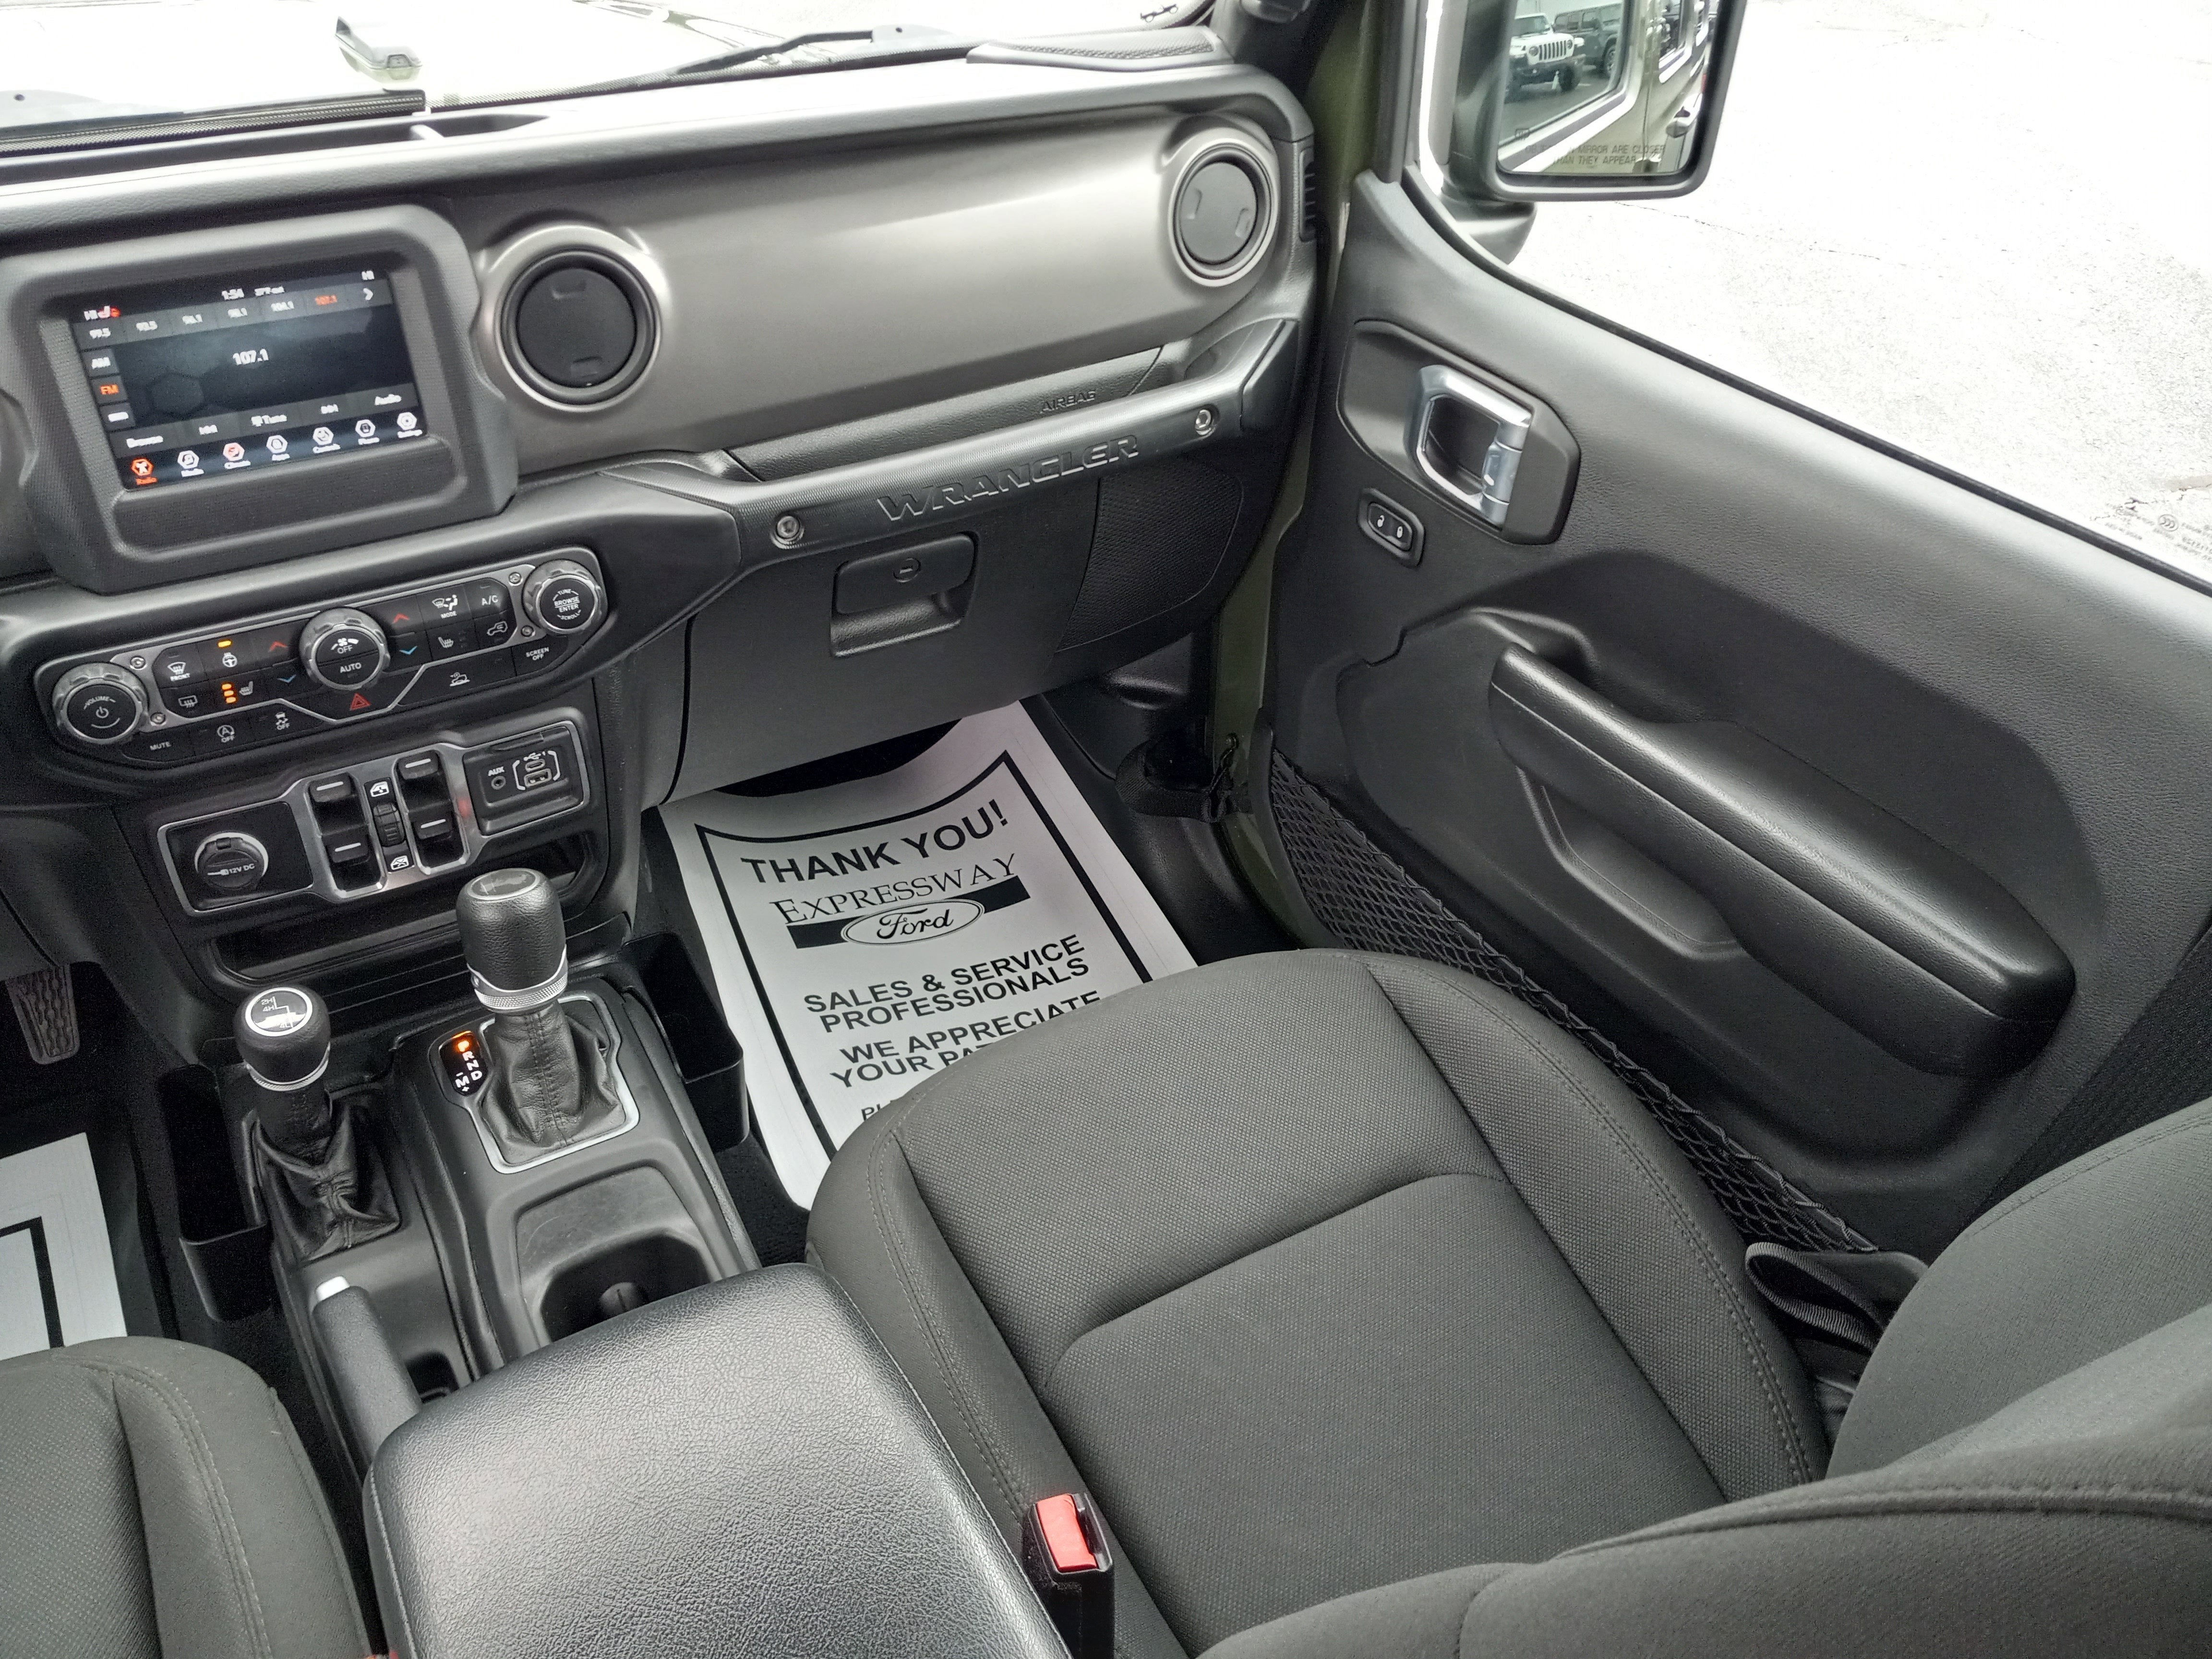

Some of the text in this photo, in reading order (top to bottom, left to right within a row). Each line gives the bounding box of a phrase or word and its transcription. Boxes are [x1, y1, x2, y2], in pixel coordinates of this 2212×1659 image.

[1611, 145, 1630, 154] ARE
[1578, 155, 1599, 164] THEY
[232, 349, 269, 365] 107.1
[1041, 389, 1095, 412] AIRBAG
[877, 434, 1140, 521] WRANGLER
[481, 595, 499, 606] A/C
[554, 596, 579, 606] BROWSE
[559, 604, 579, 613] ENTER
[441, 611, 457, 619] MODE
[337, 645, 353, 654] OFF
[526, 647, 550, 658] SCREEN
[532, 653, 544, 661] OFF
[340, 662, 362, 673] AUTO
[85, 696, 110, 706] VOLUME
[150, 742, 171, 750] MUTE
[488, 766, 505, 776] AUX
[740, 799, 1009, 883] THANK YOU!
[769, 853, 1016, 925] EXPRESSWAY
[876, 908, 954, 939] Ford
[804, 934, 1085, 1013] SALES & SERVICE
[819, 957, 1090, 1033] PROFESSIONALS
[839, 1040, 900, 1064] WE
[908, 990, 1101, 1054] APPRECIATE
[457, 1040, 469, 1052] P
[462, 1051, 475, 1061] R
[466, 1059, 479, 1070] N
[470, 1070, 482, 1081] D
[830, 1055, 935, 1088] YOUR
[455, 1075, 470, 1088] M
